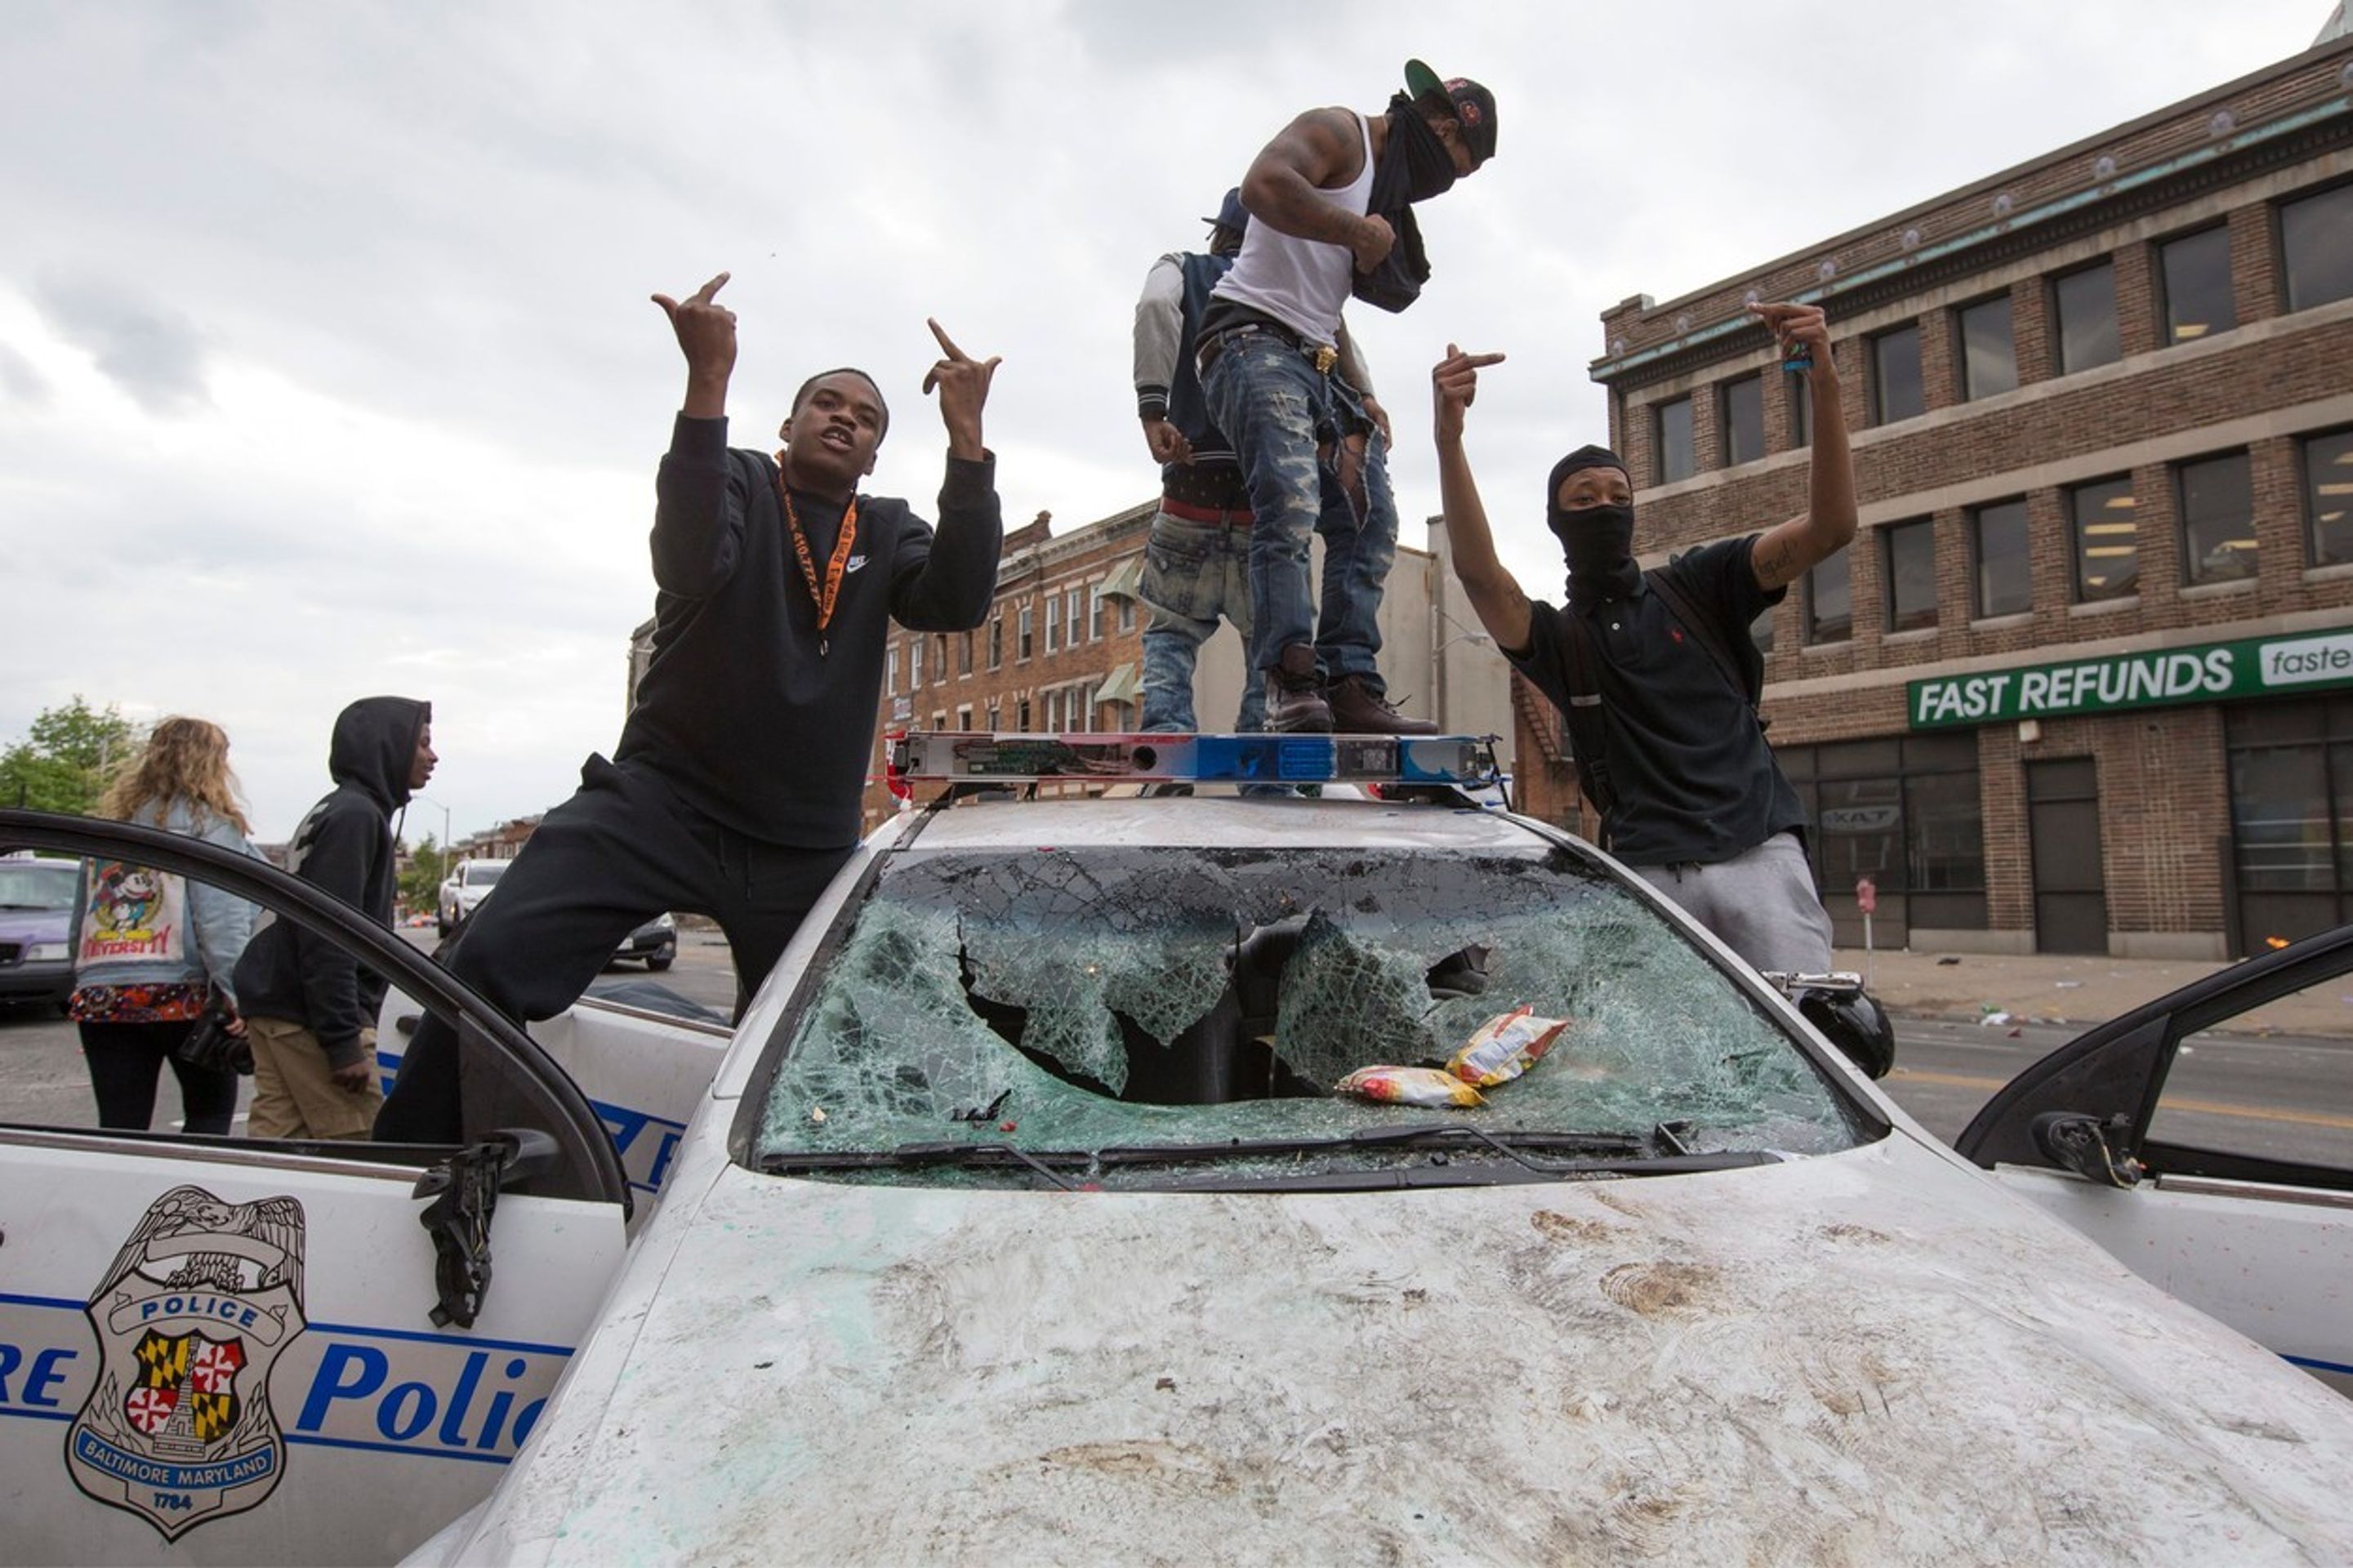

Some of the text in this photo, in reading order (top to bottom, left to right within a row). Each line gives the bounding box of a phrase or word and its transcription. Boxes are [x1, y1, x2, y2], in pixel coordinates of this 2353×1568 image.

[2272, 646, 2353, 675] faste
[1918, 648, 2234, 722] FAST REFUNDS
[141, 1296, 258, 1328] POLICE
[84, 1441, 267, 1485] BALTIMORE MARYLAND
[154, 1492, 193, 1510] 1784
